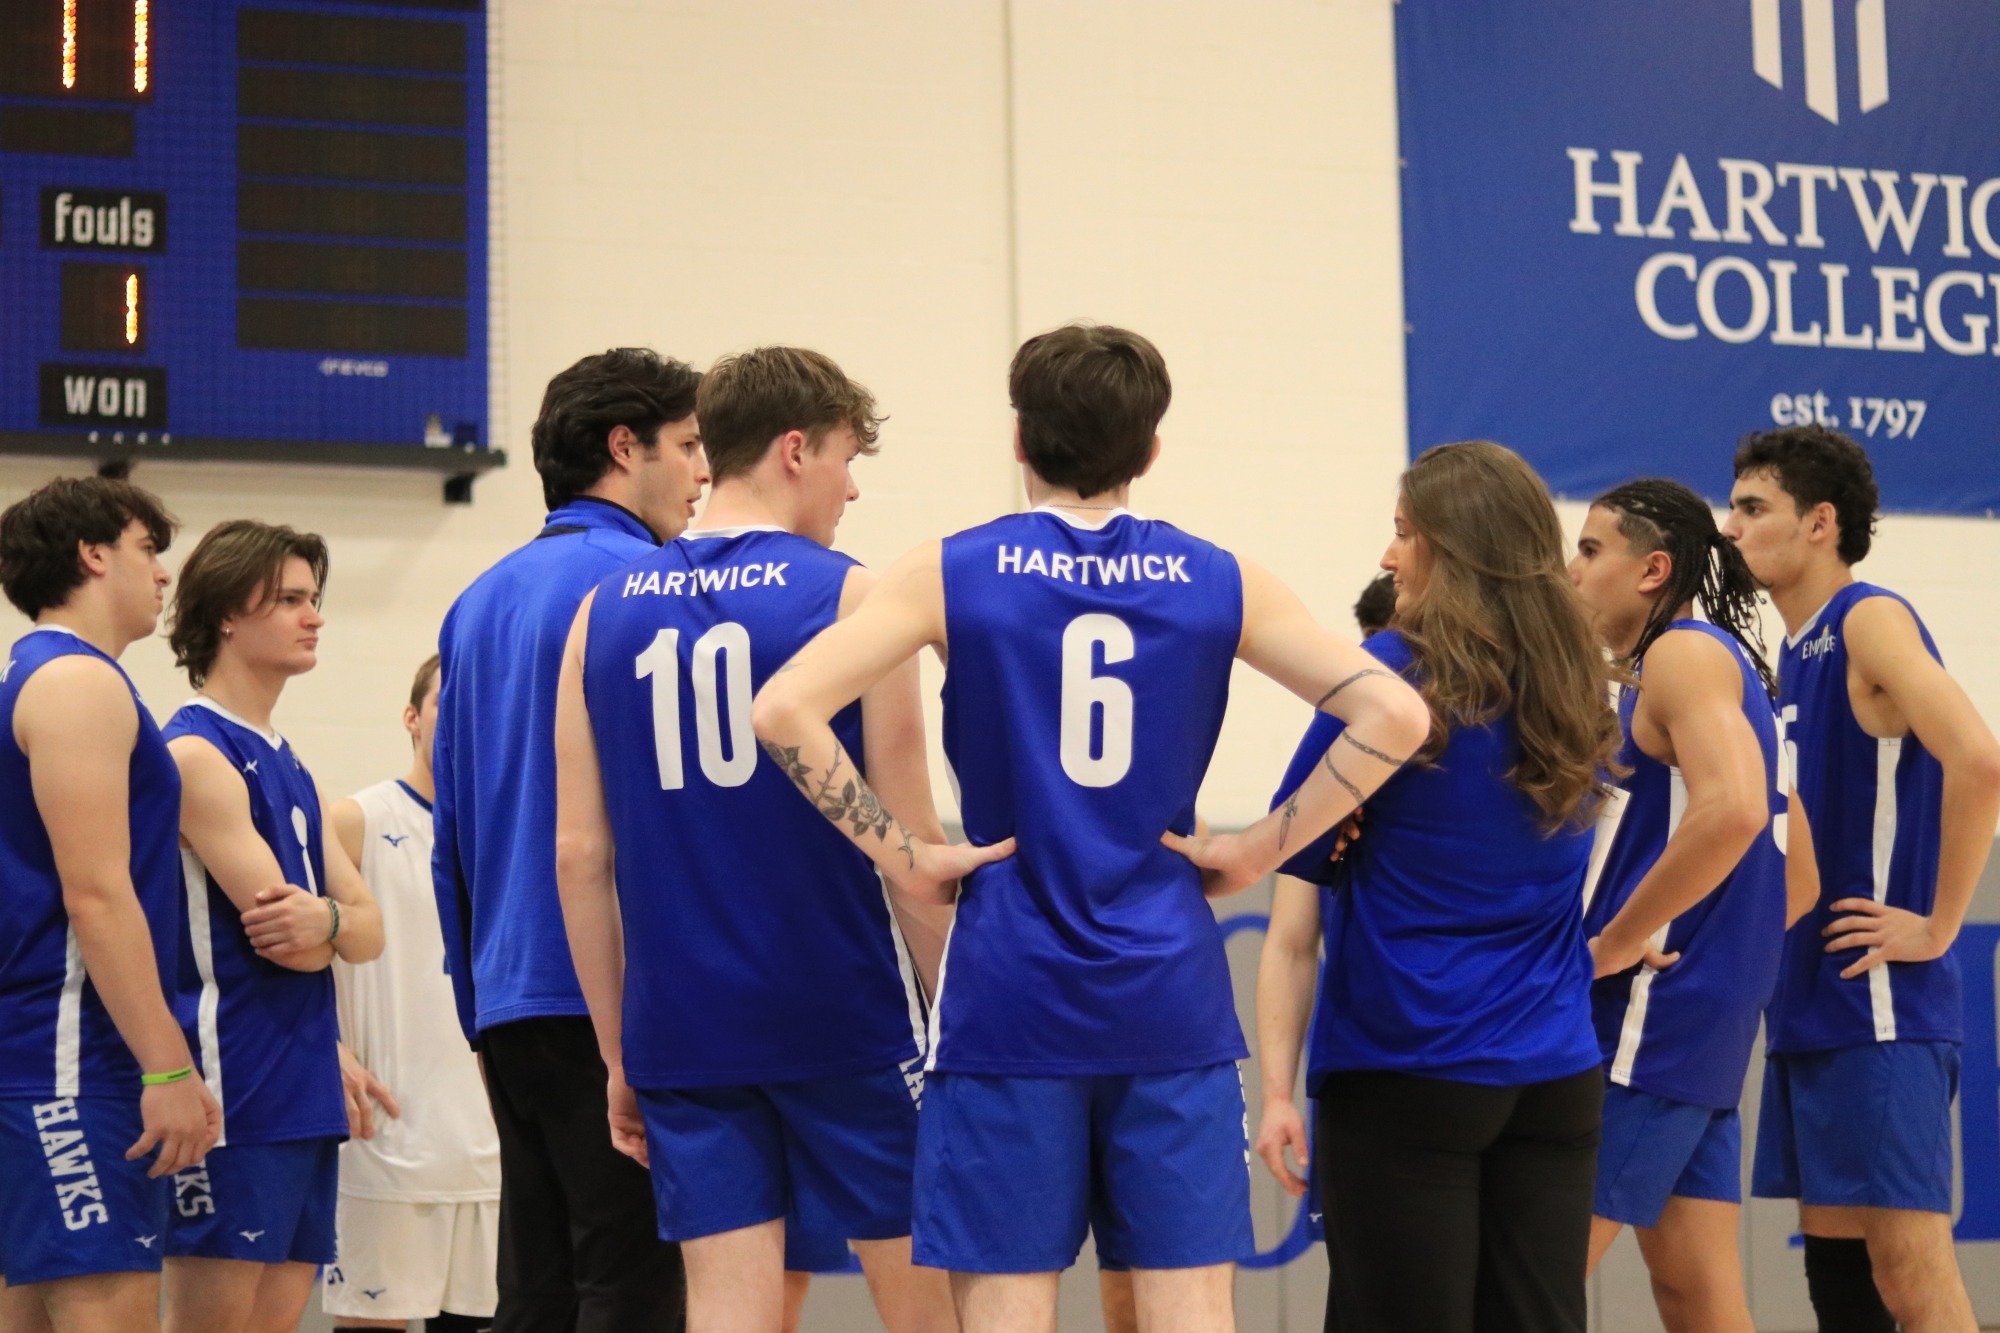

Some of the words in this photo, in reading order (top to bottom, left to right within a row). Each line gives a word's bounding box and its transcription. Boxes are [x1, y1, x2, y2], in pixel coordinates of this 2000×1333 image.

[55, 193, 154, 247] fouls
[125, 273, 138, 344] 1
[1634, 252, 2000, 357] COLLEG
[64, 376, 146, 417] won
[1770, 389, 1840, 429] est.
[1849, 397, 1927, 440] 1797
[622, 562, 790, 598] HARTWICK
[997, 545, 1192, 586] HARTWICK
[635, 622, 757, 790] 10
[1060, 613, 1135, 788] 6
[32, 1098, 109, 1231] HAWKS
